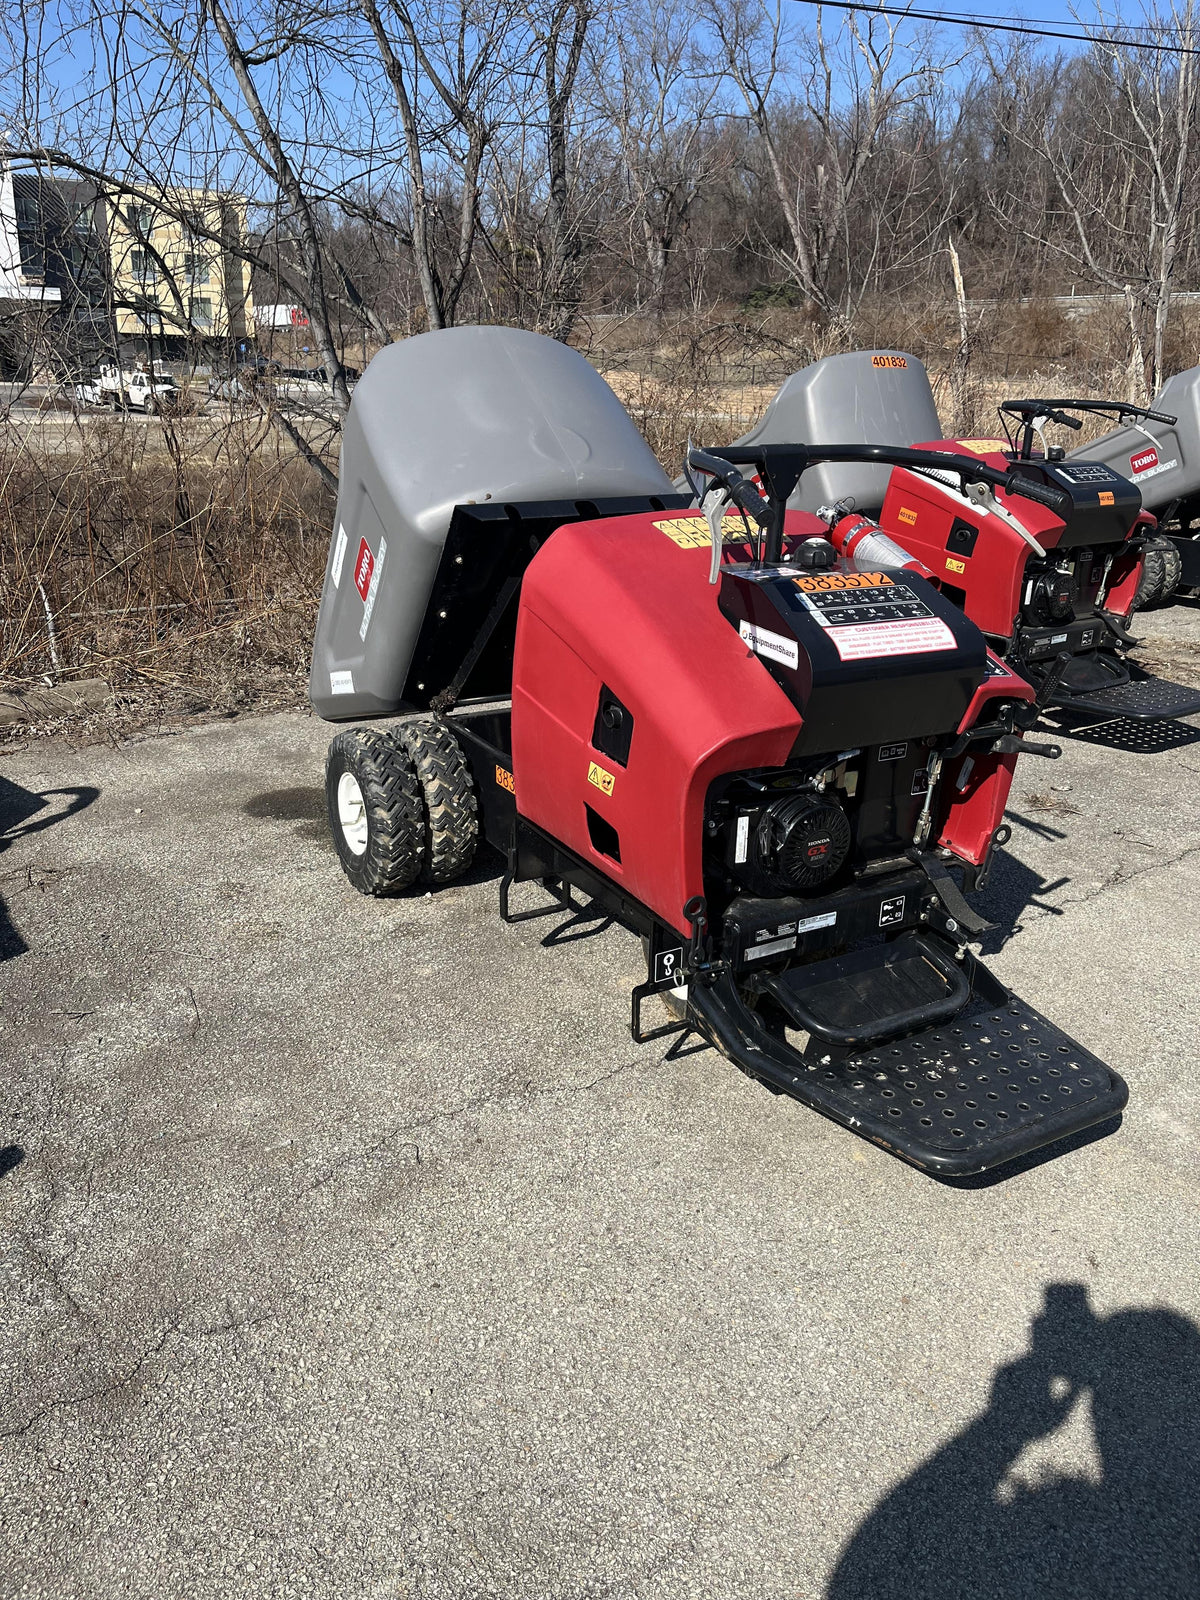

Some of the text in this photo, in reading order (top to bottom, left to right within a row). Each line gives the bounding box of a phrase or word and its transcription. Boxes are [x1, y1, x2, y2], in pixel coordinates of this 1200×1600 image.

[873, 356, 907, 368] 401832
[1132, 453, 1156, 468] TORO
[1147, 459, 1175, 477] BUGGY
[357, 549, 371, 590] TORO
[796, 572, 893, 591] 383512
[360, 595, 375, 637] ULTRA
[855, 624, 890, 633] CUSTOMER
[890, 619, 942, 630] RESPONSIBILITY
[748, 632, 796, 659] EquipmentShare
[807, 838, 831, 847] HONDA
[807, 844, 830, 856] GX
